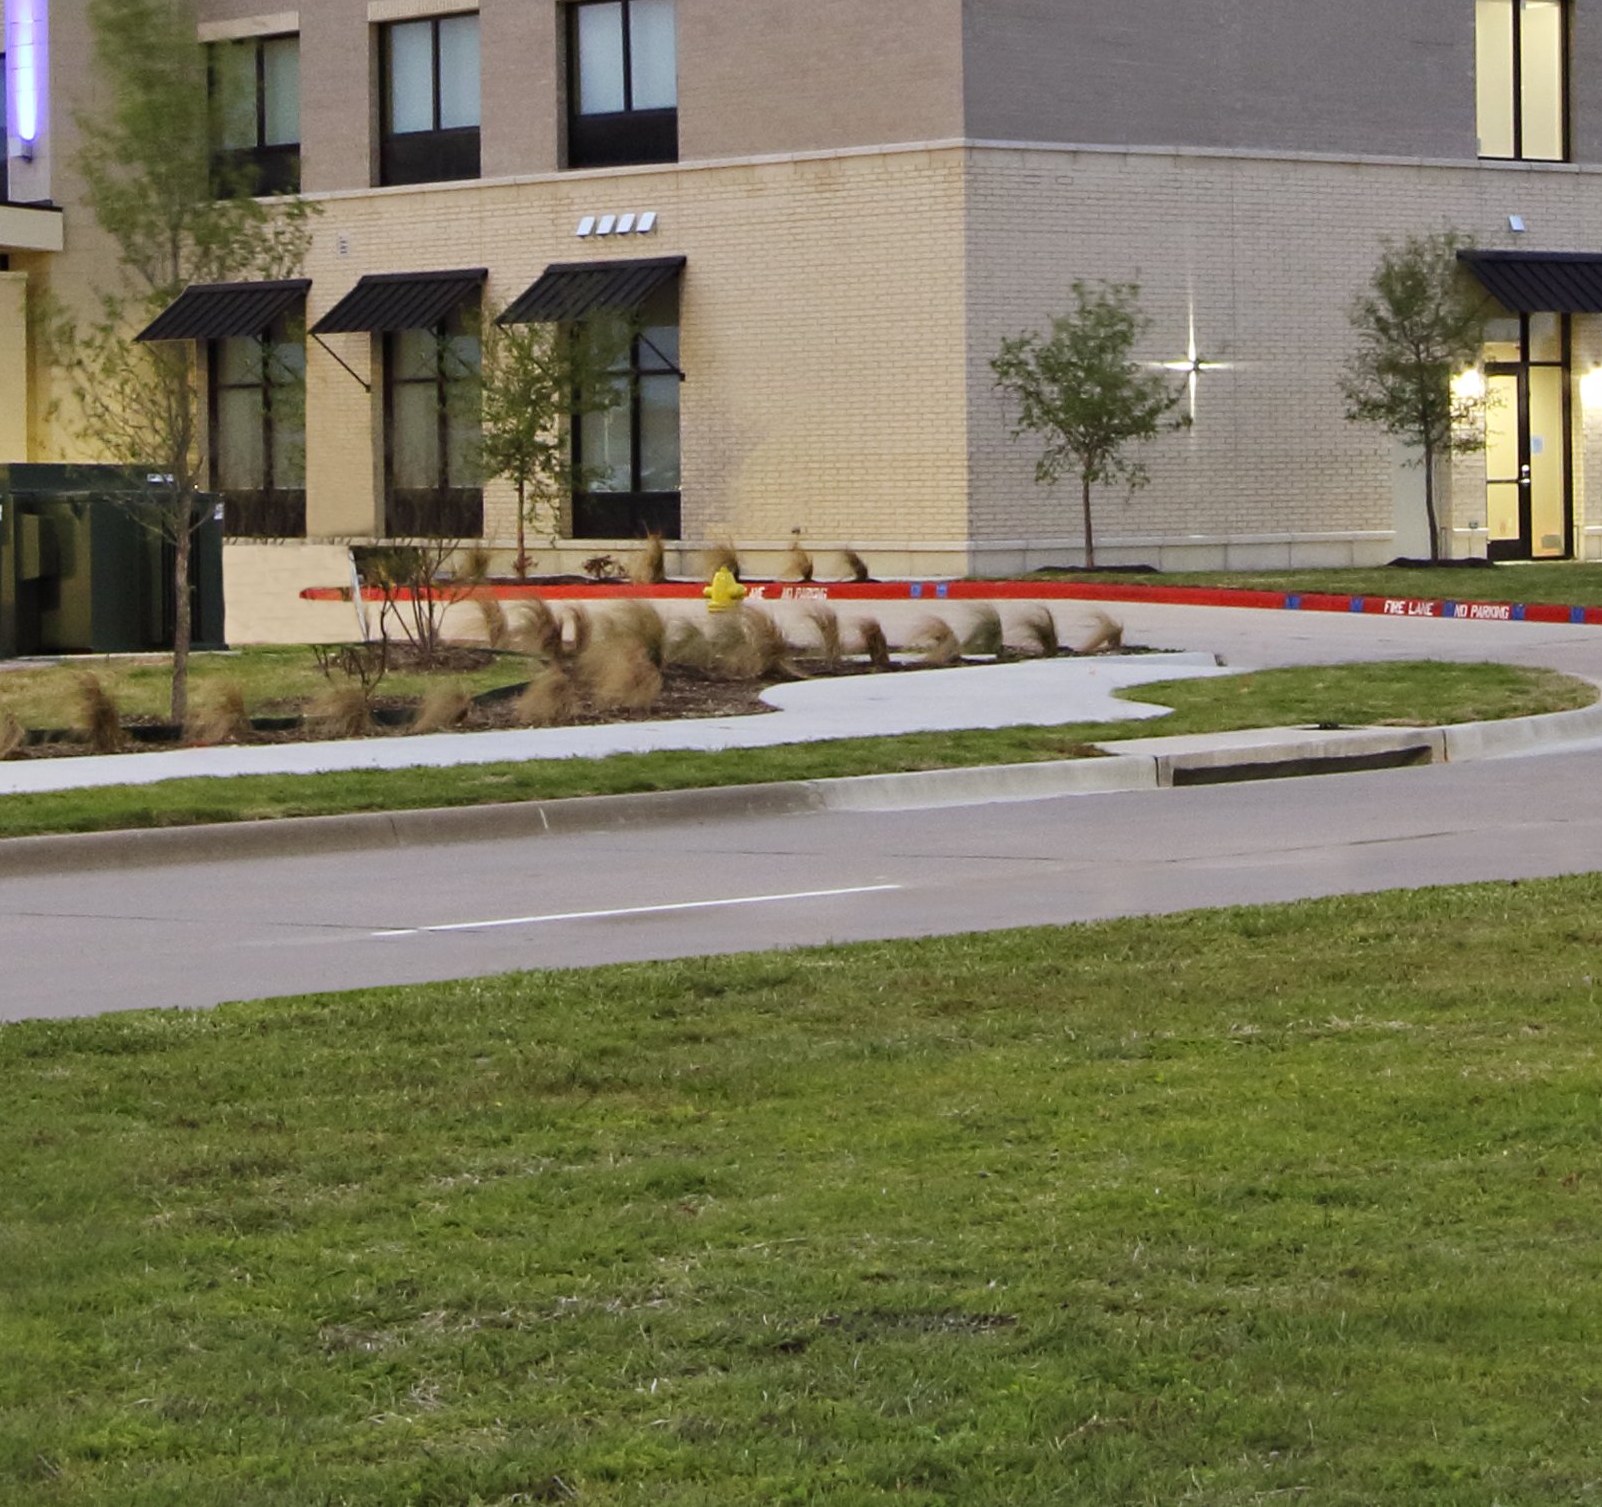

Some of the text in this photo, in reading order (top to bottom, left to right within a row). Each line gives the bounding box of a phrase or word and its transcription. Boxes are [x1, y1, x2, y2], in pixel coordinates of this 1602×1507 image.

[1384, 600, 1510, 620] FIRE LANE NO PARKING
